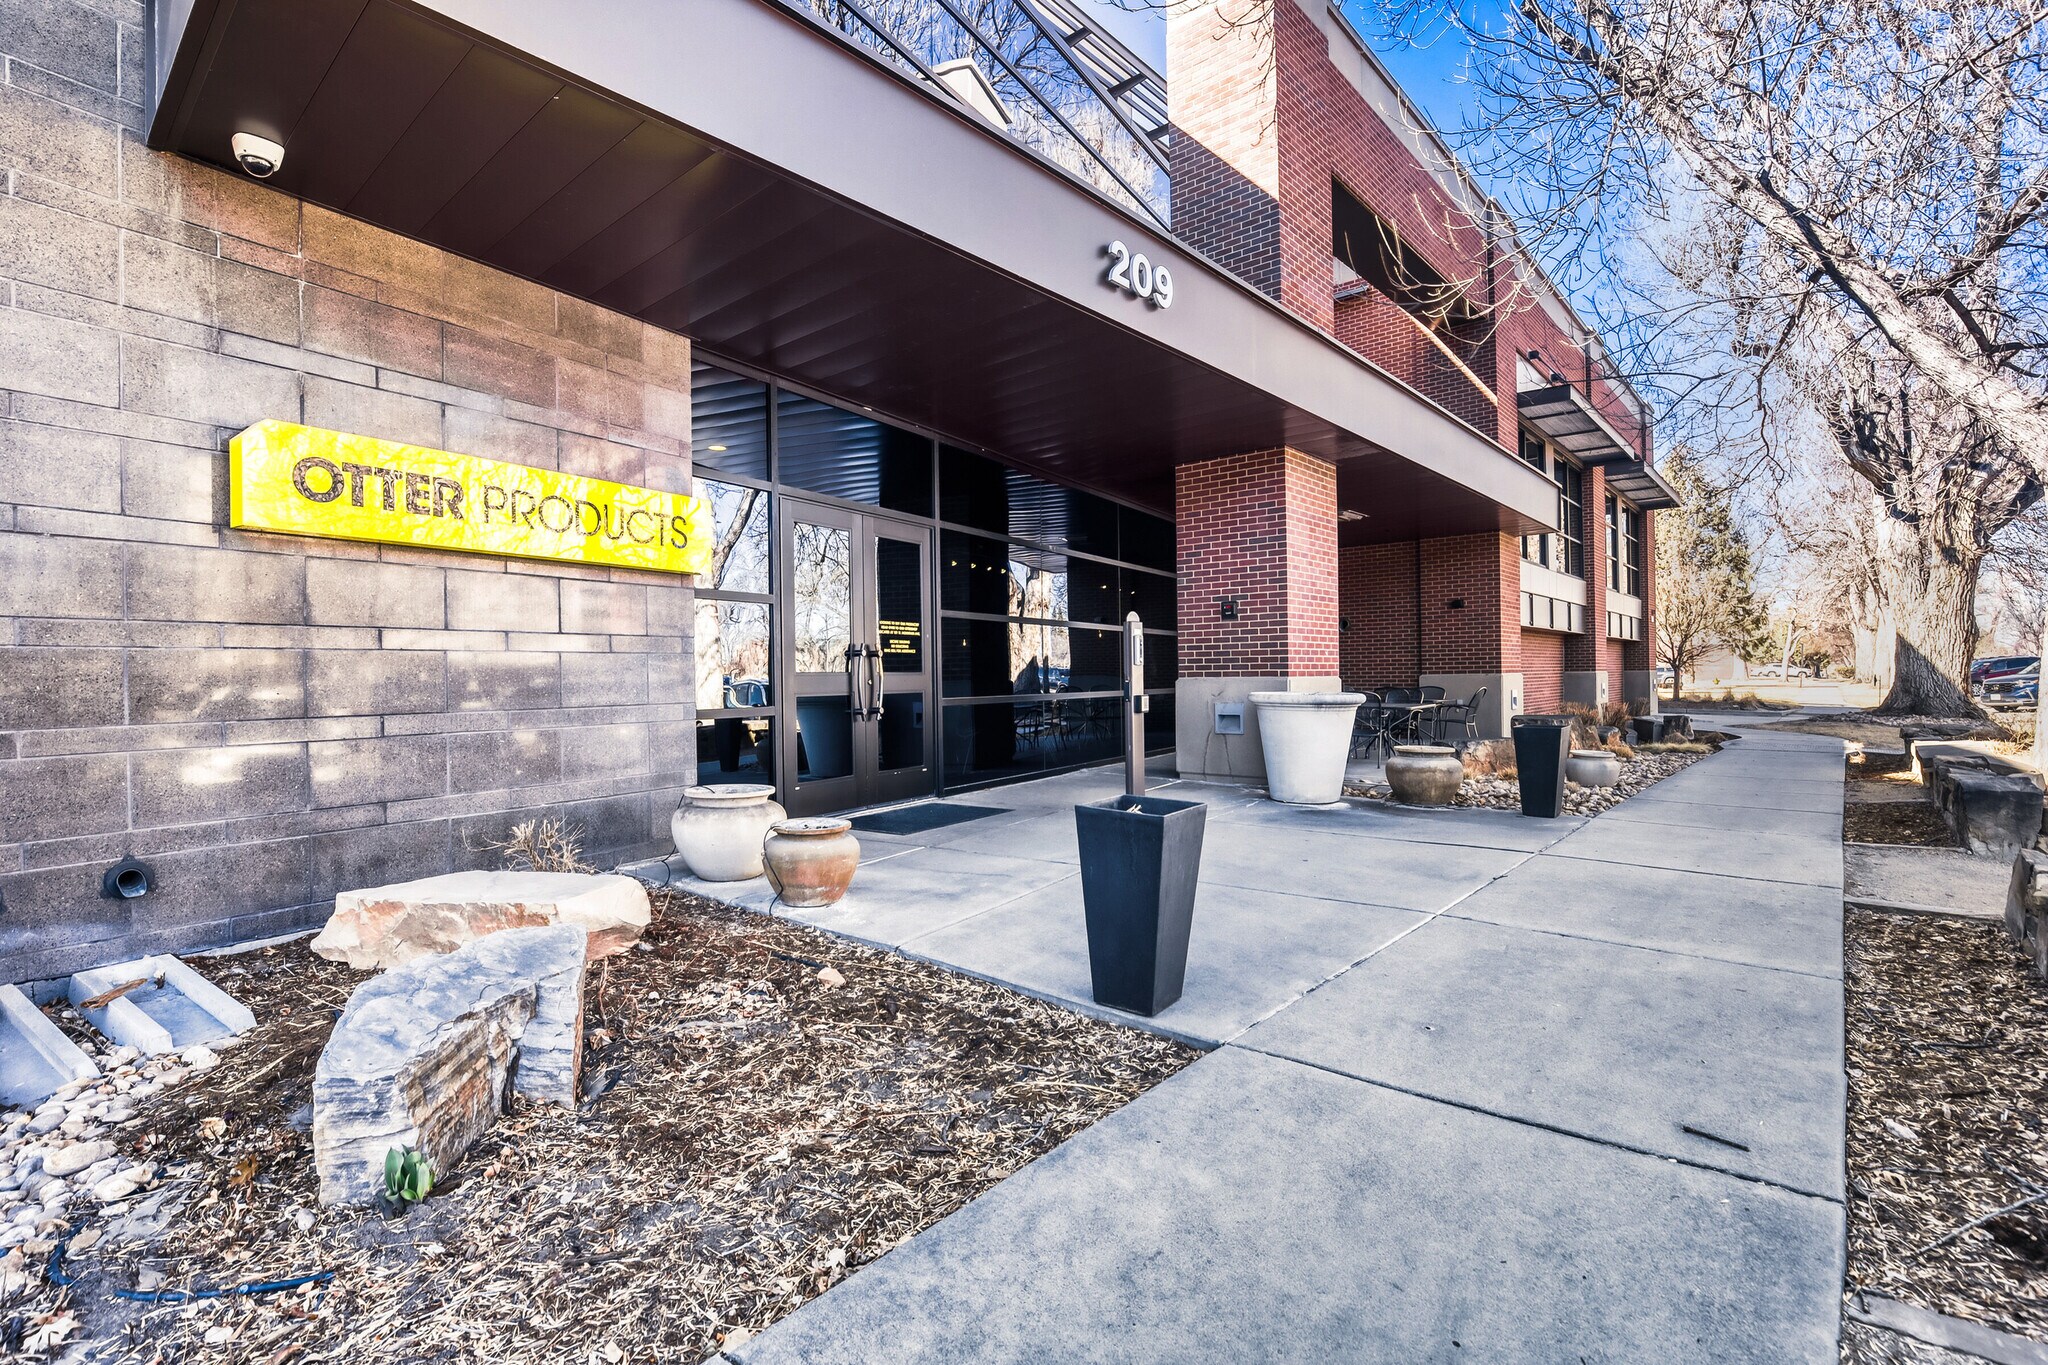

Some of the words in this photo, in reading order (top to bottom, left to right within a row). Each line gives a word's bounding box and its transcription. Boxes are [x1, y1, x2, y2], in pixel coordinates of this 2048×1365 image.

[1107, 239, 1174, 309] 209
[292, 456, 465, 520] OTTER
[483, 484, 688, 549] PRODUCTS
